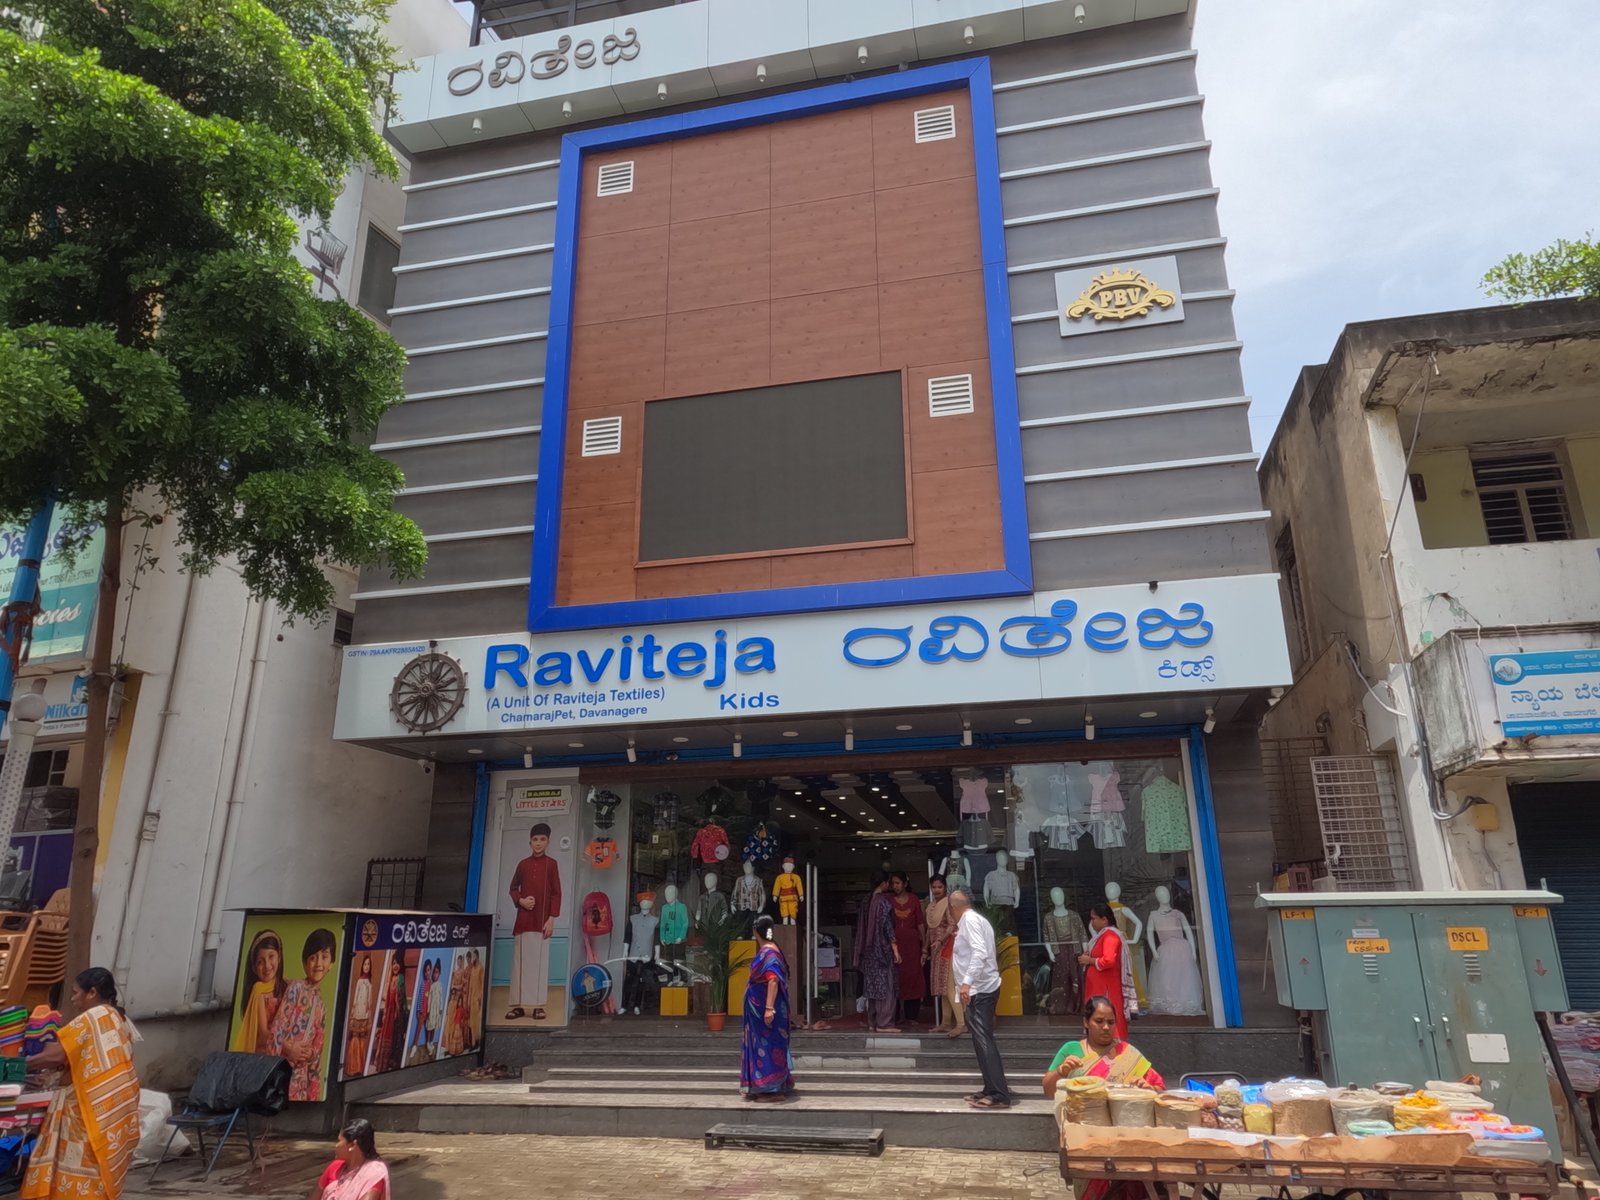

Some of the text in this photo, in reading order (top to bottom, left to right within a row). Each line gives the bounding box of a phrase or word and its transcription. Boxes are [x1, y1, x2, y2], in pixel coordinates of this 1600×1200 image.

[447, 27, 641, 97] ರವಿತೇಜ
[1099, 287, 1141, 308] PBV
[842, 599, 1214, 669] ರವಿತೇಜ
[483, 629, 777, 691] Raviteja
[1158, 655, 1216, 683] ಕಿಡ್ಸ್
[486, 686, 666, 712] (A Unit Of Raviteja Textiles)
[719, 691, 780, 711] Kids
[500, 706, 648, 723] ChamarajPet, Davanagere
[391, 918, 448, 943] ರವಿತೇಜ
[1451, 932, 1480, 942] DSCL
